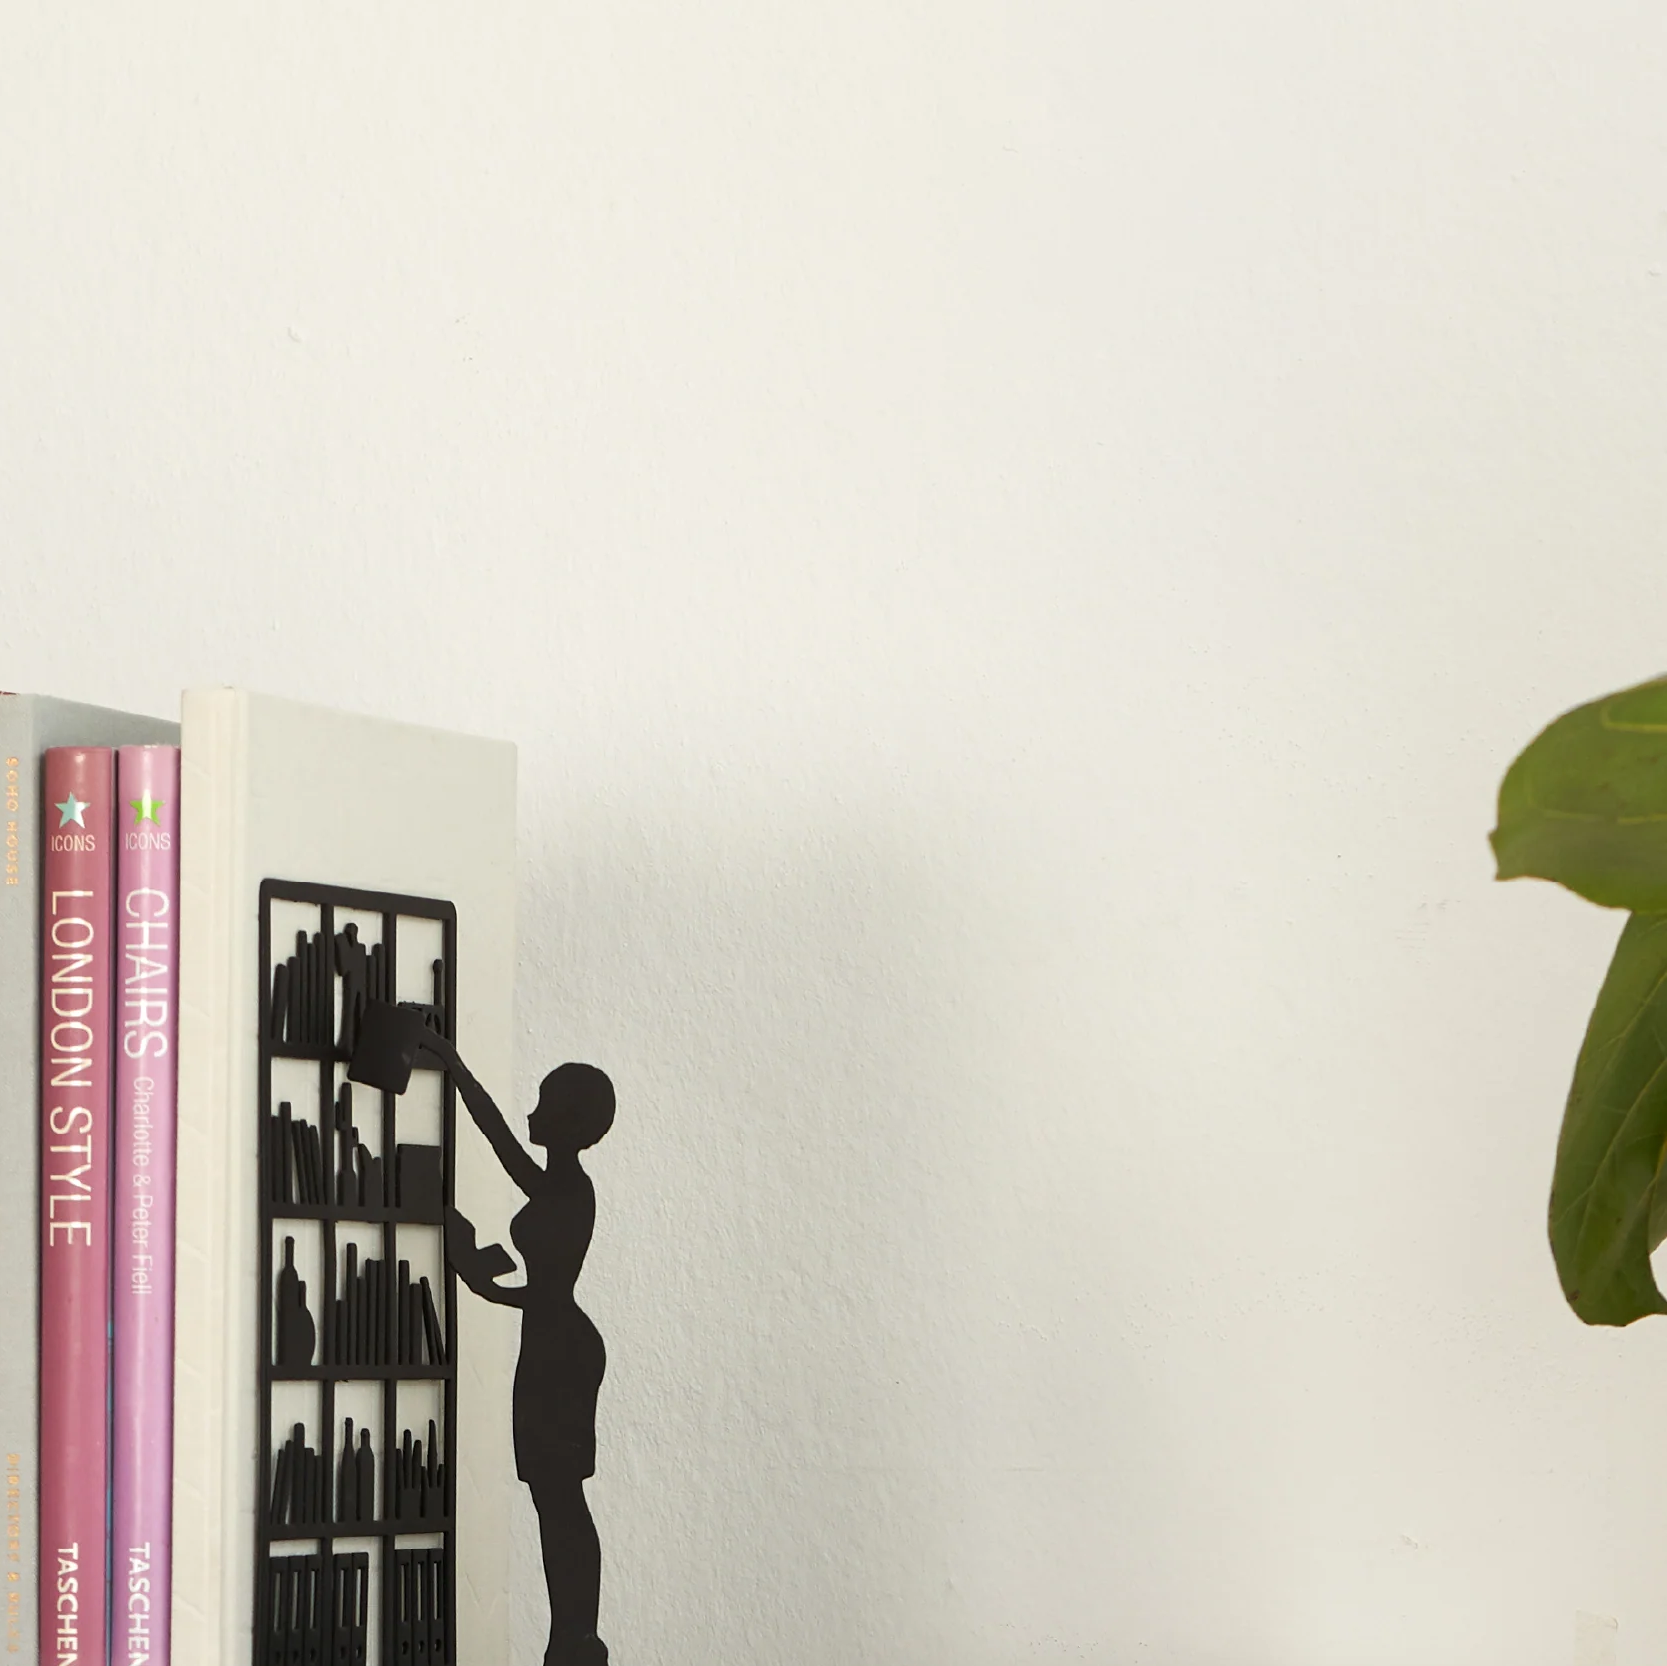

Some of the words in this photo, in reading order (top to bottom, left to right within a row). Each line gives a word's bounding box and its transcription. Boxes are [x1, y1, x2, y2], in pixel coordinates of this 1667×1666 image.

[6, 756, 19, 812] SOHO
[6, 821, 19, 886] HOUSE
[50, 834, 96, 851] ICONS
[125, 832, 171, 850] ICONS
[51, 891, 94, 1087] LONDON
[123, 887, 170, 1059] CHAIRS
[133, 1076, 155, 1167] Charlotte
[50, 1106, 93, 1247] STYLE
[133, 1174, 152, 1188] &
[132, 1194, 154, 1249] Peter
[131, 1254, 153, 1295] Fiell
